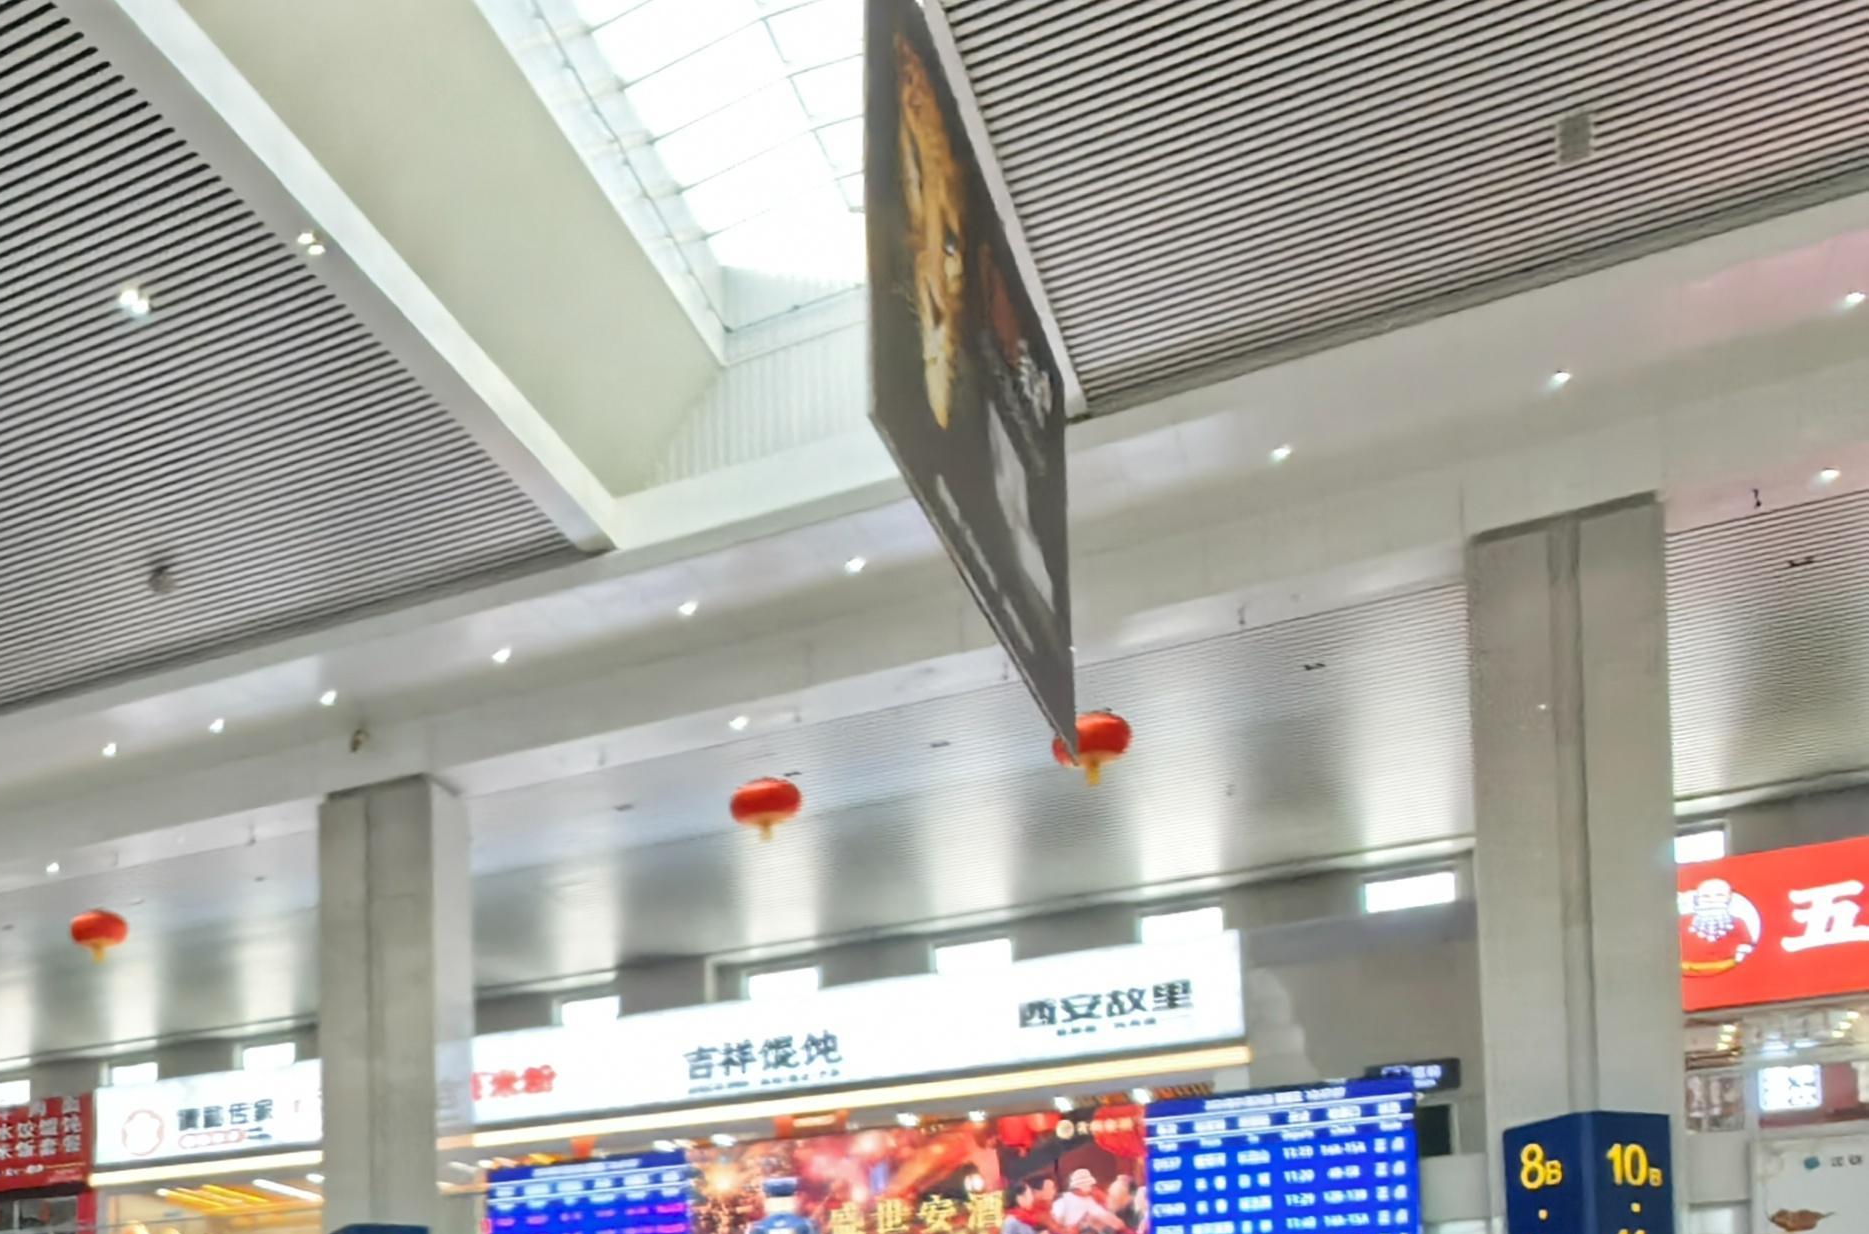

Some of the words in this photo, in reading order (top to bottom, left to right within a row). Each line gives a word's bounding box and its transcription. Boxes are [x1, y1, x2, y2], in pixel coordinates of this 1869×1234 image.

[1780, 880, 1869, 953] 五
[1018, 978, 1194, 1028] 西安故里
[683, 1029, 843, 1082] 吉祥馄饨
[1520, 1143, 1563, 1189] 8B
[1606, 1143, 1663, 1187] 10B
